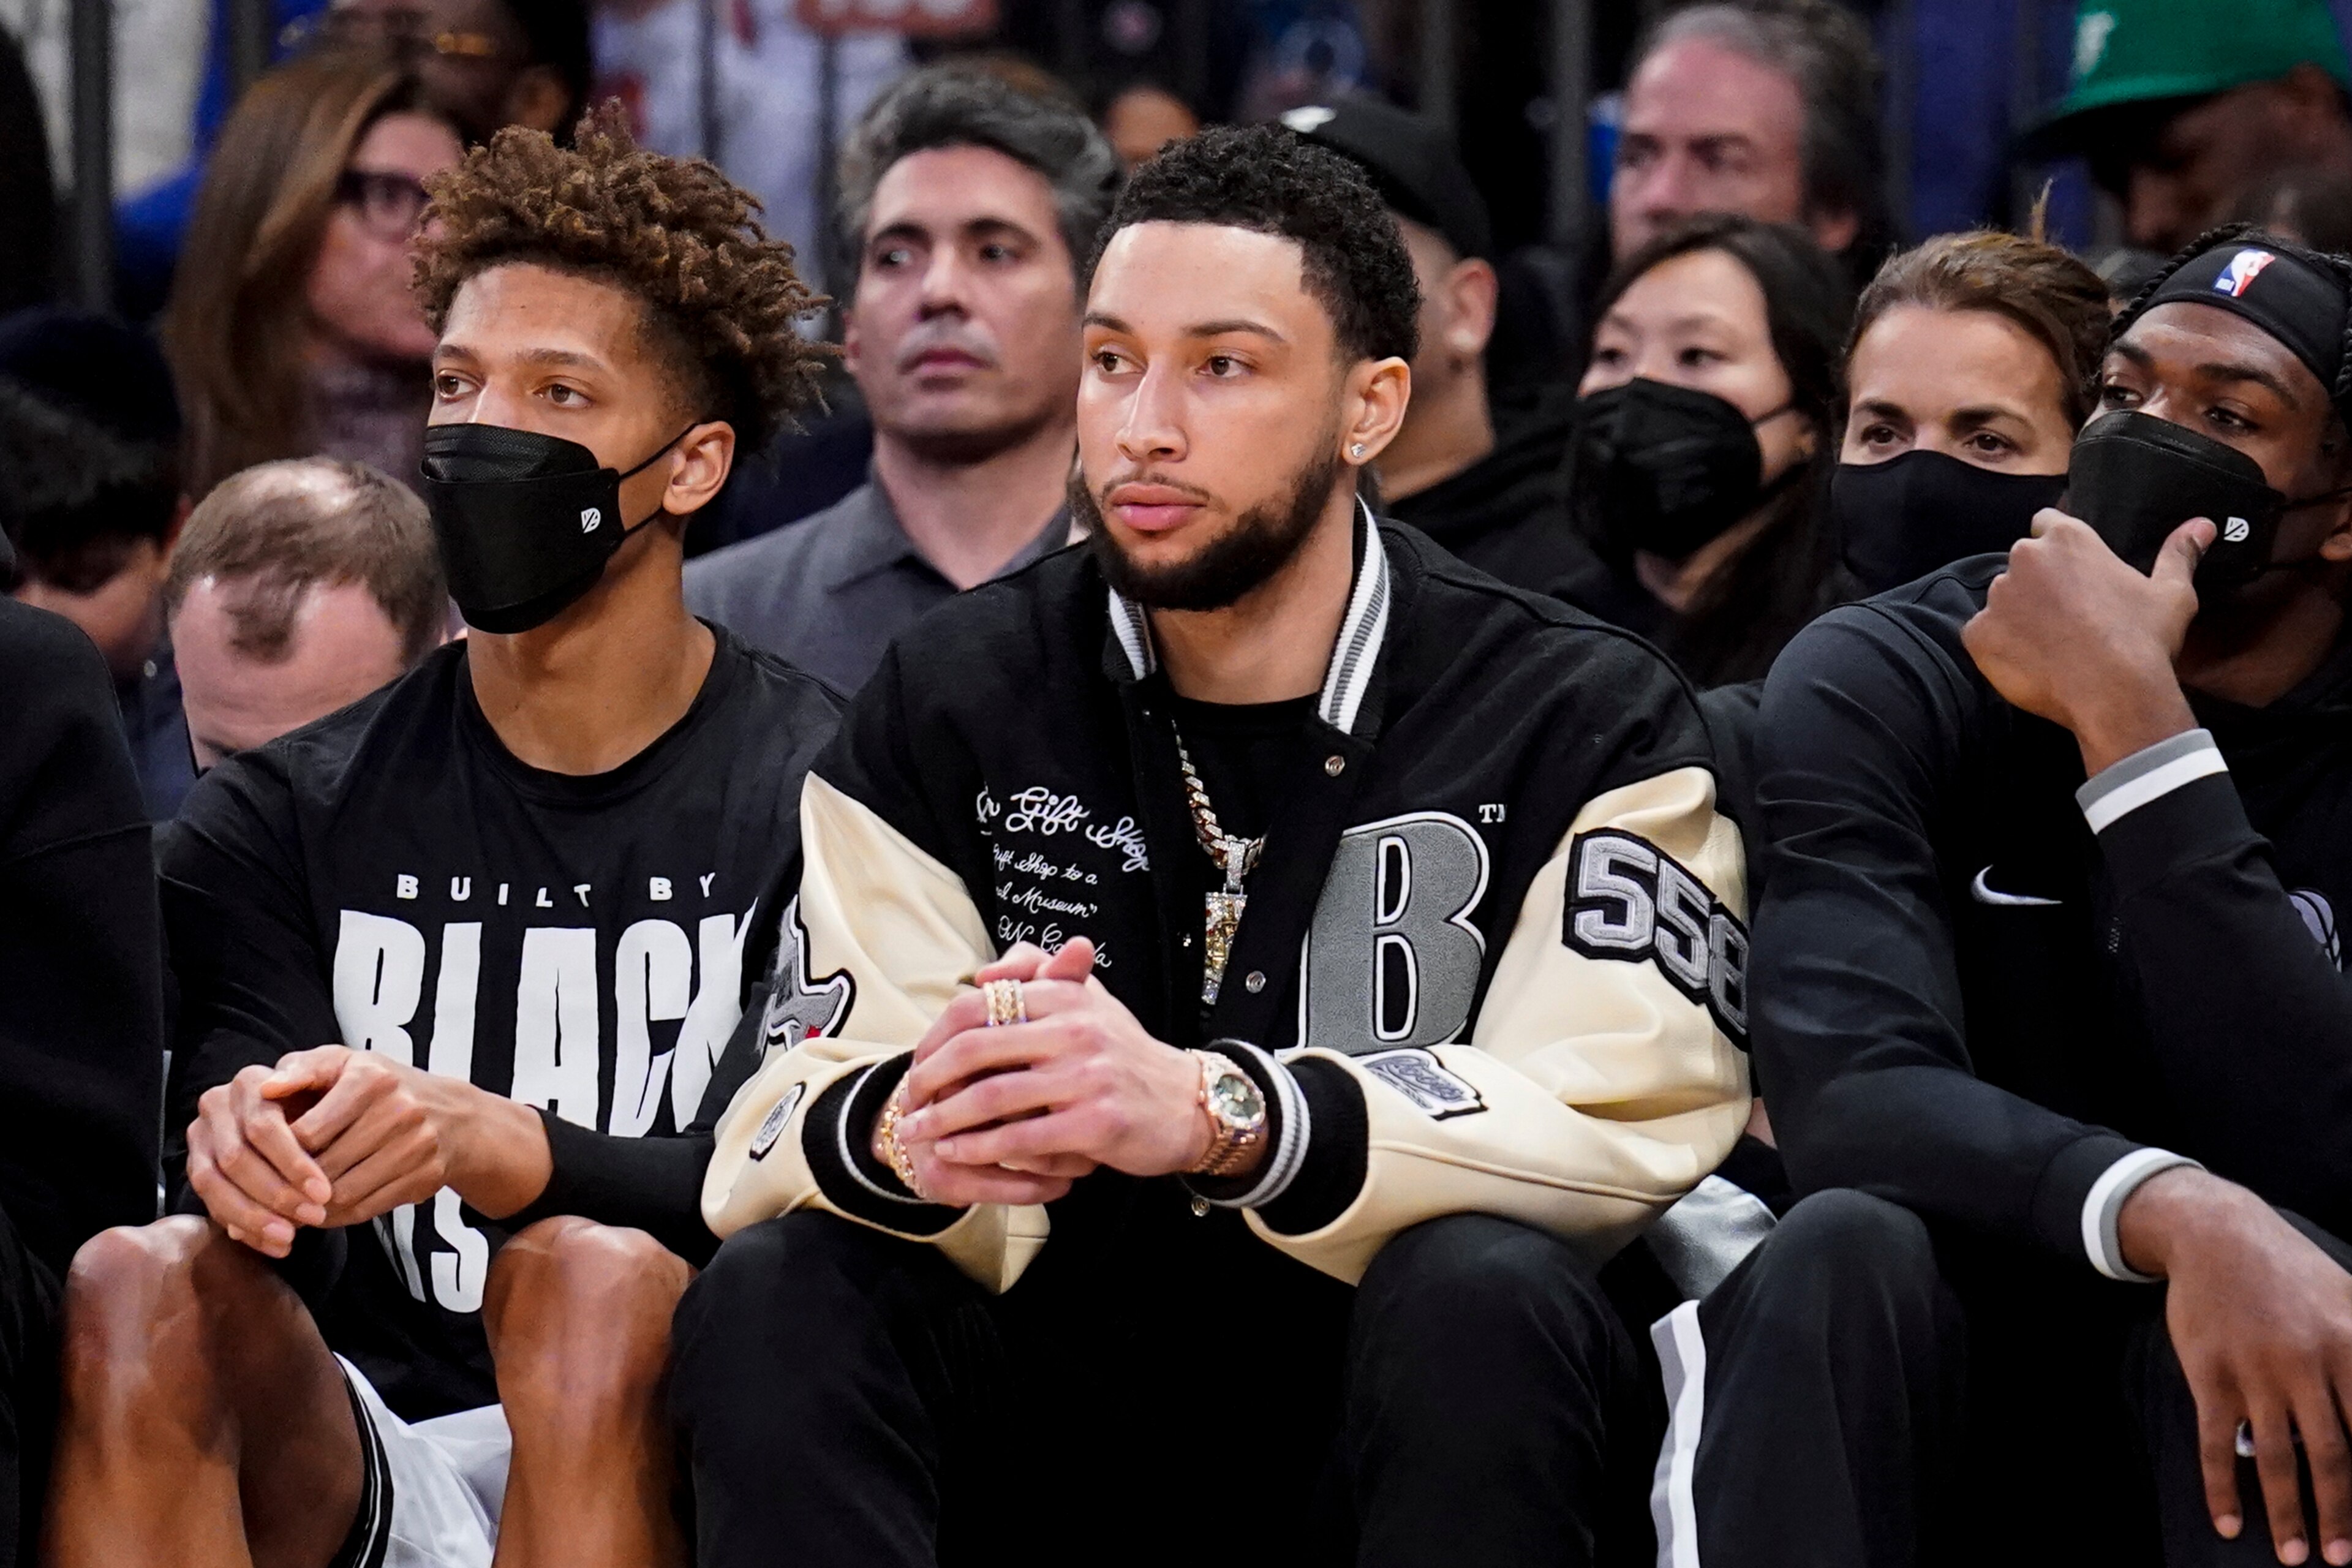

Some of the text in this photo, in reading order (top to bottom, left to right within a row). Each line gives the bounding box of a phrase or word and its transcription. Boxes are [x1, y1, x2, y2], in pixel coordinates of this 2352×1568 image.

[1006, 786, 1090, 835] Gift
[1014, 852, 1058, 880] Shop
[1060, 862, 1084, 881] to
[1085, 873, 1098, 884] a
[396, 872, 715, 907] BUILT BY
[1274, 810, 1490, 1057] B
